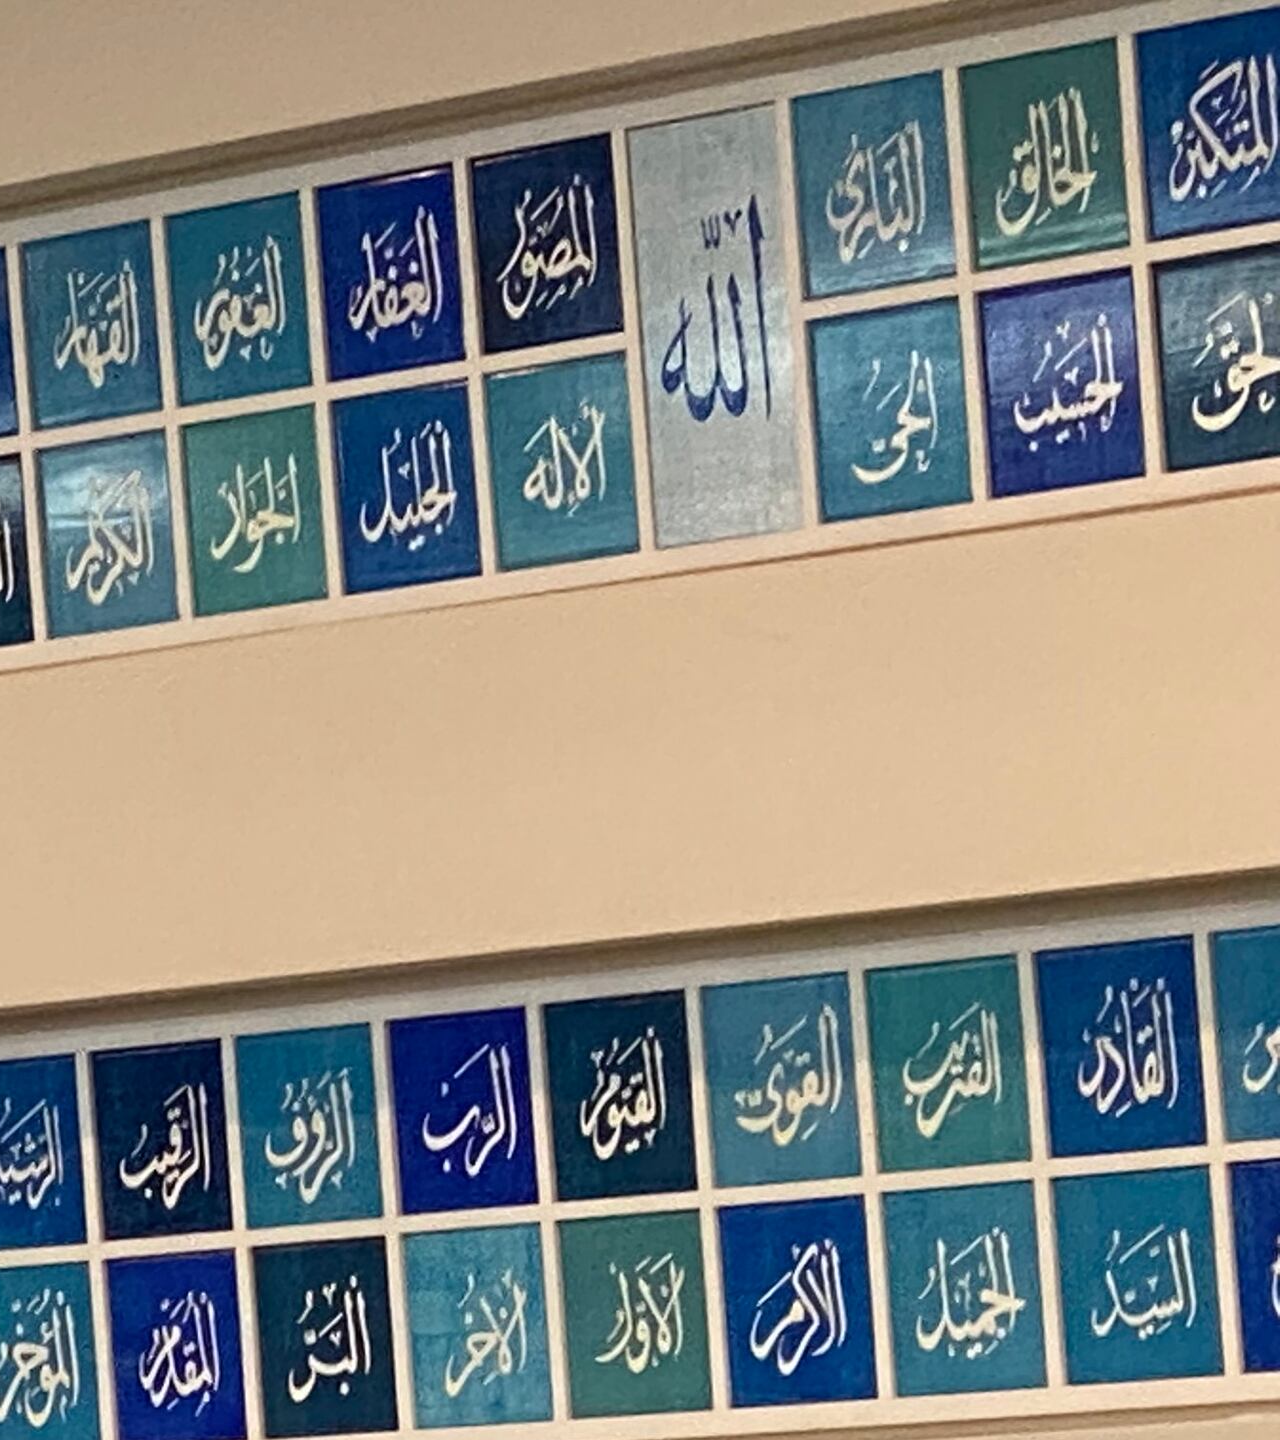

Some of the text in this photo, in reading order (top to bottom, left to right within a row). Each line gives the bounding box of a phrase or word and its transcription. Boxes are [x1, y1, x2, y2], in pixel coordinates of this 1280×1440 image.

[996, 87, 1100, 236] الخالق
[662, 194, 771, 423] الله
[422, 1044, 517, 1177] الرب
